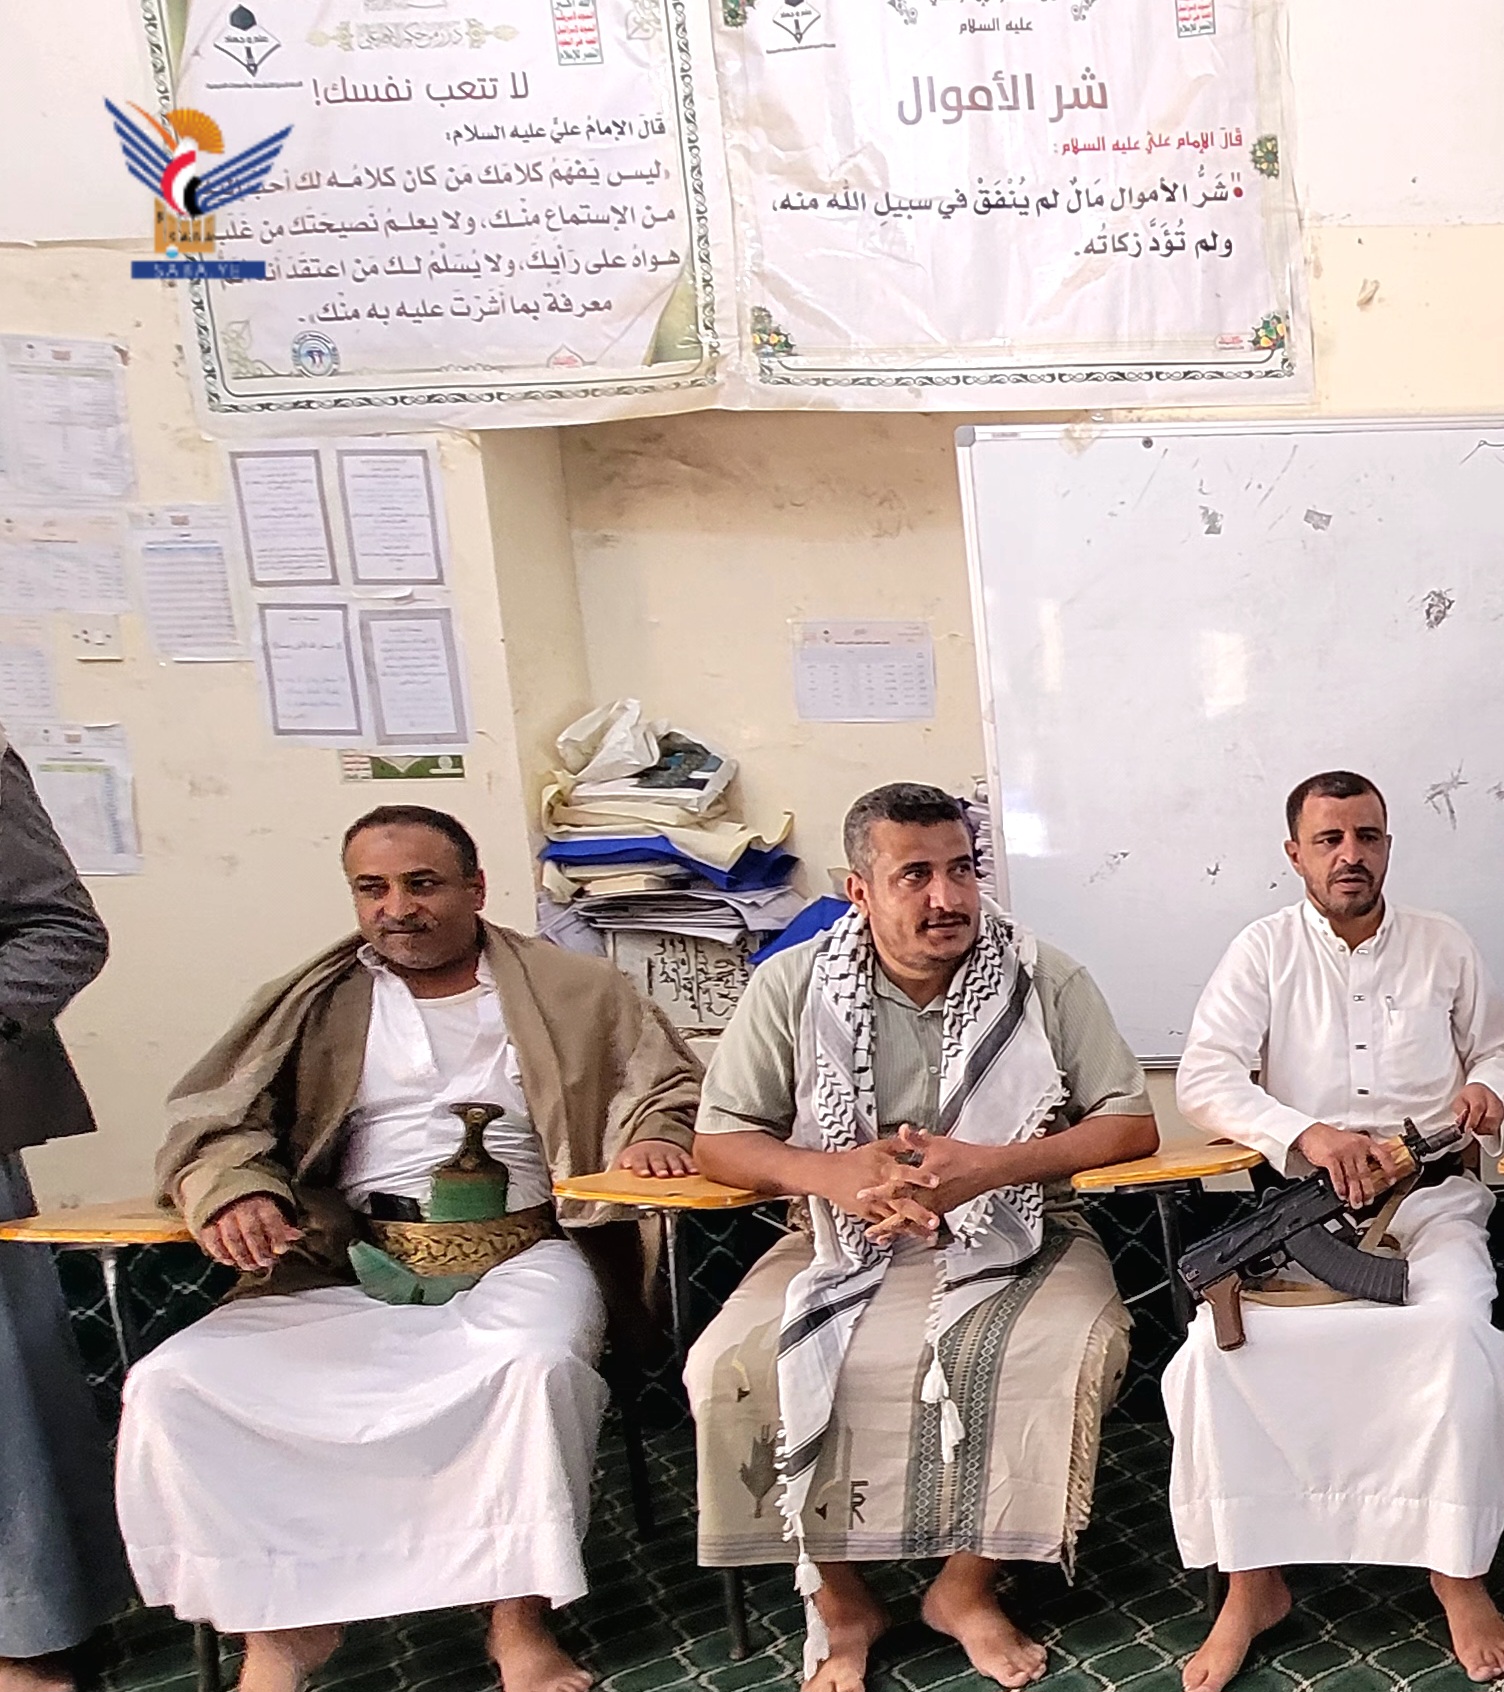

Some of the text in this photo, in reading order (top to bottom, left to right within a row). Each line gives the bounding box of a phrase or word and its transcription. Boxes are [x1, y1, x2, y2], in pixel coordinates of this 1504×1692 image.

[959, 17, 1033, 35] عليه السلام
[312, 71, 529, 108] لا تتعب نفسك!
[897, 66, 1108, 125] شر الأموال
[509, 122, 547, 143] عليه
[1112, 136, 1140, 154] عليه
[295, 170, 321, 190] لك
[403, 165, 437, 193] كان
[937, 187, 968, 219] في
[1036, 188, 1060, 217] لم
[1110, 176, 1188, 211] الأموال
[442, 209, 476, 235] ولا
[641, 205, 676, 229] من
[1194, 230, 1233, 259] ولم
[384, 255, 422, 275] لك
[484, 253, 515, 278] ولا
[585, 248, 627, 275] على
[366, 303, 390, 326] به
[396, 299, 444, 324] عليه
[511, 295, 540, 321] بما
